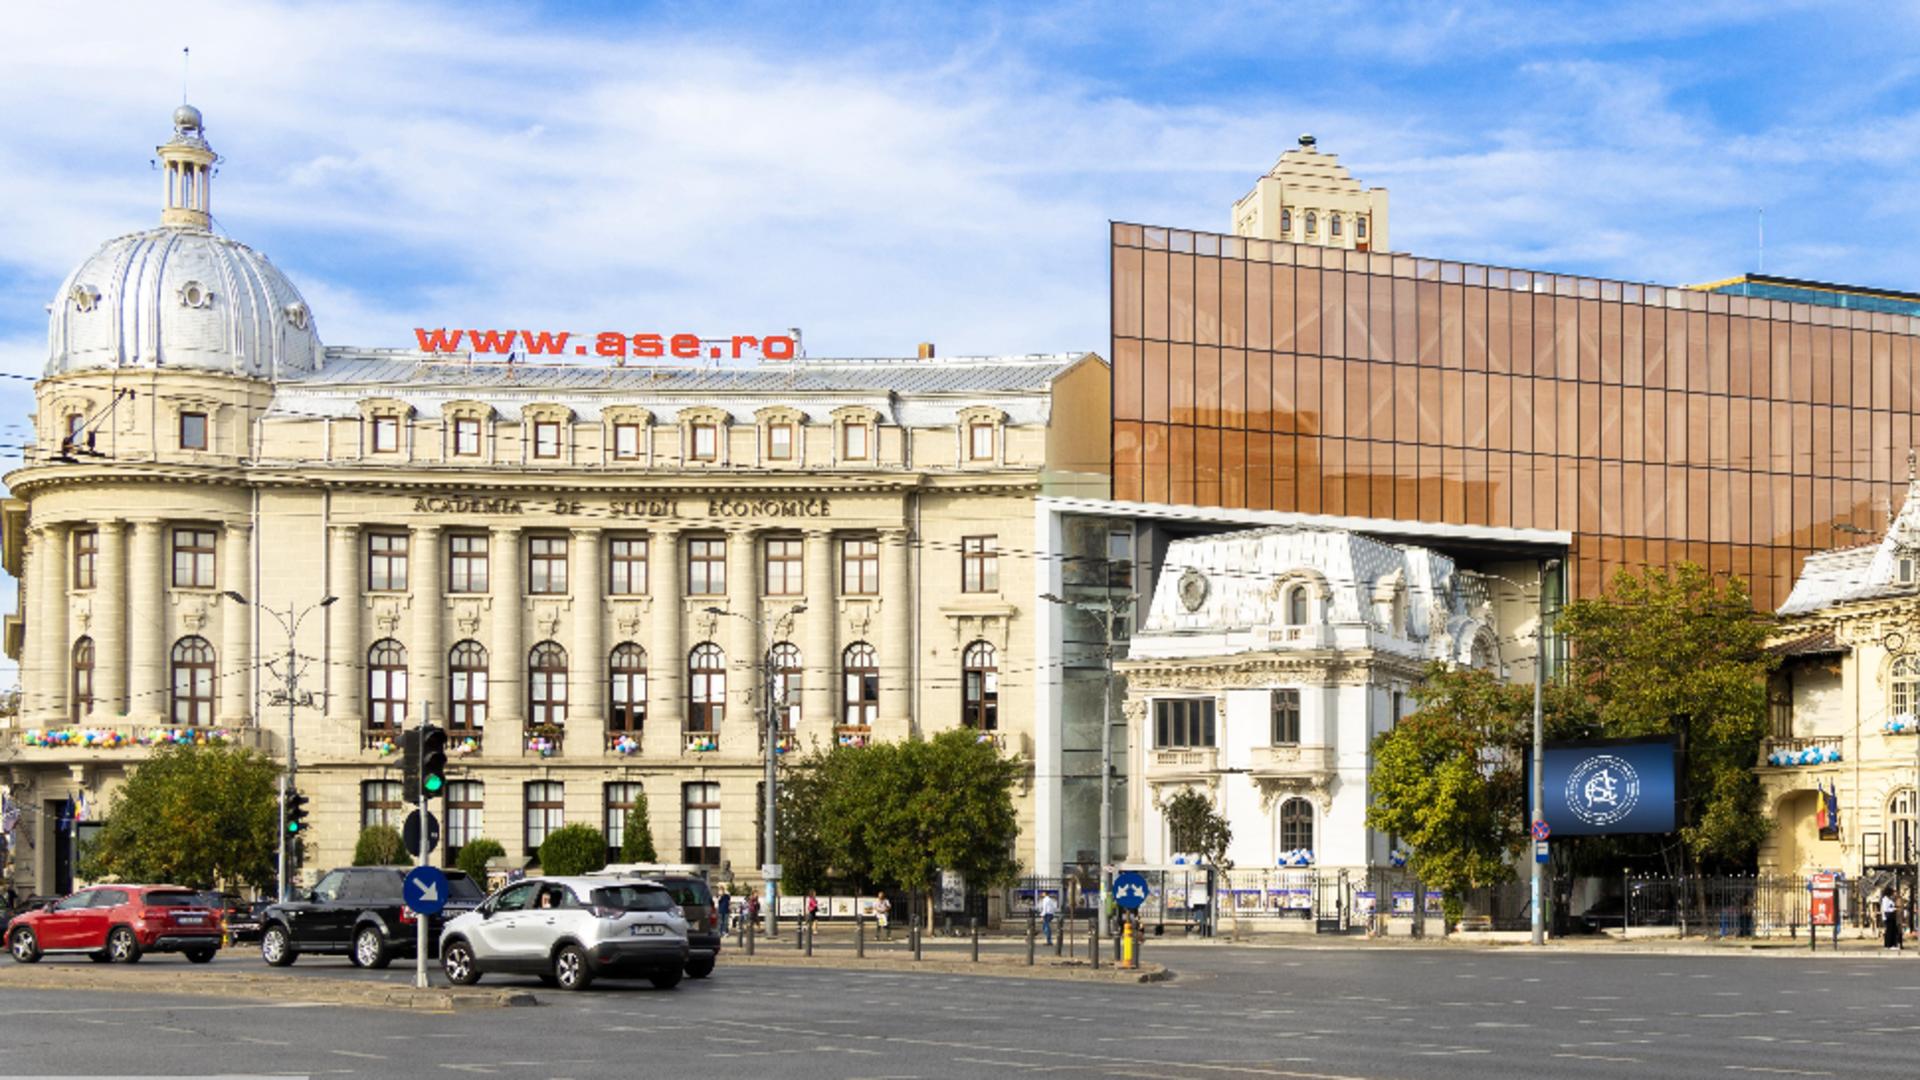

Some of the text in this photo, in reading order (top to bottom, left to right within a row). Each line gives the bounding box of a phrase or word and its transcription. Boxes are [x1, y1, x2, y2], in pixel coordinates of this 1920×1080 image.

[414, 328, 794, 360] www.ase.ro
[414, 498, 830, 517] ACADEMIA DE STUDII ECONOMICE
